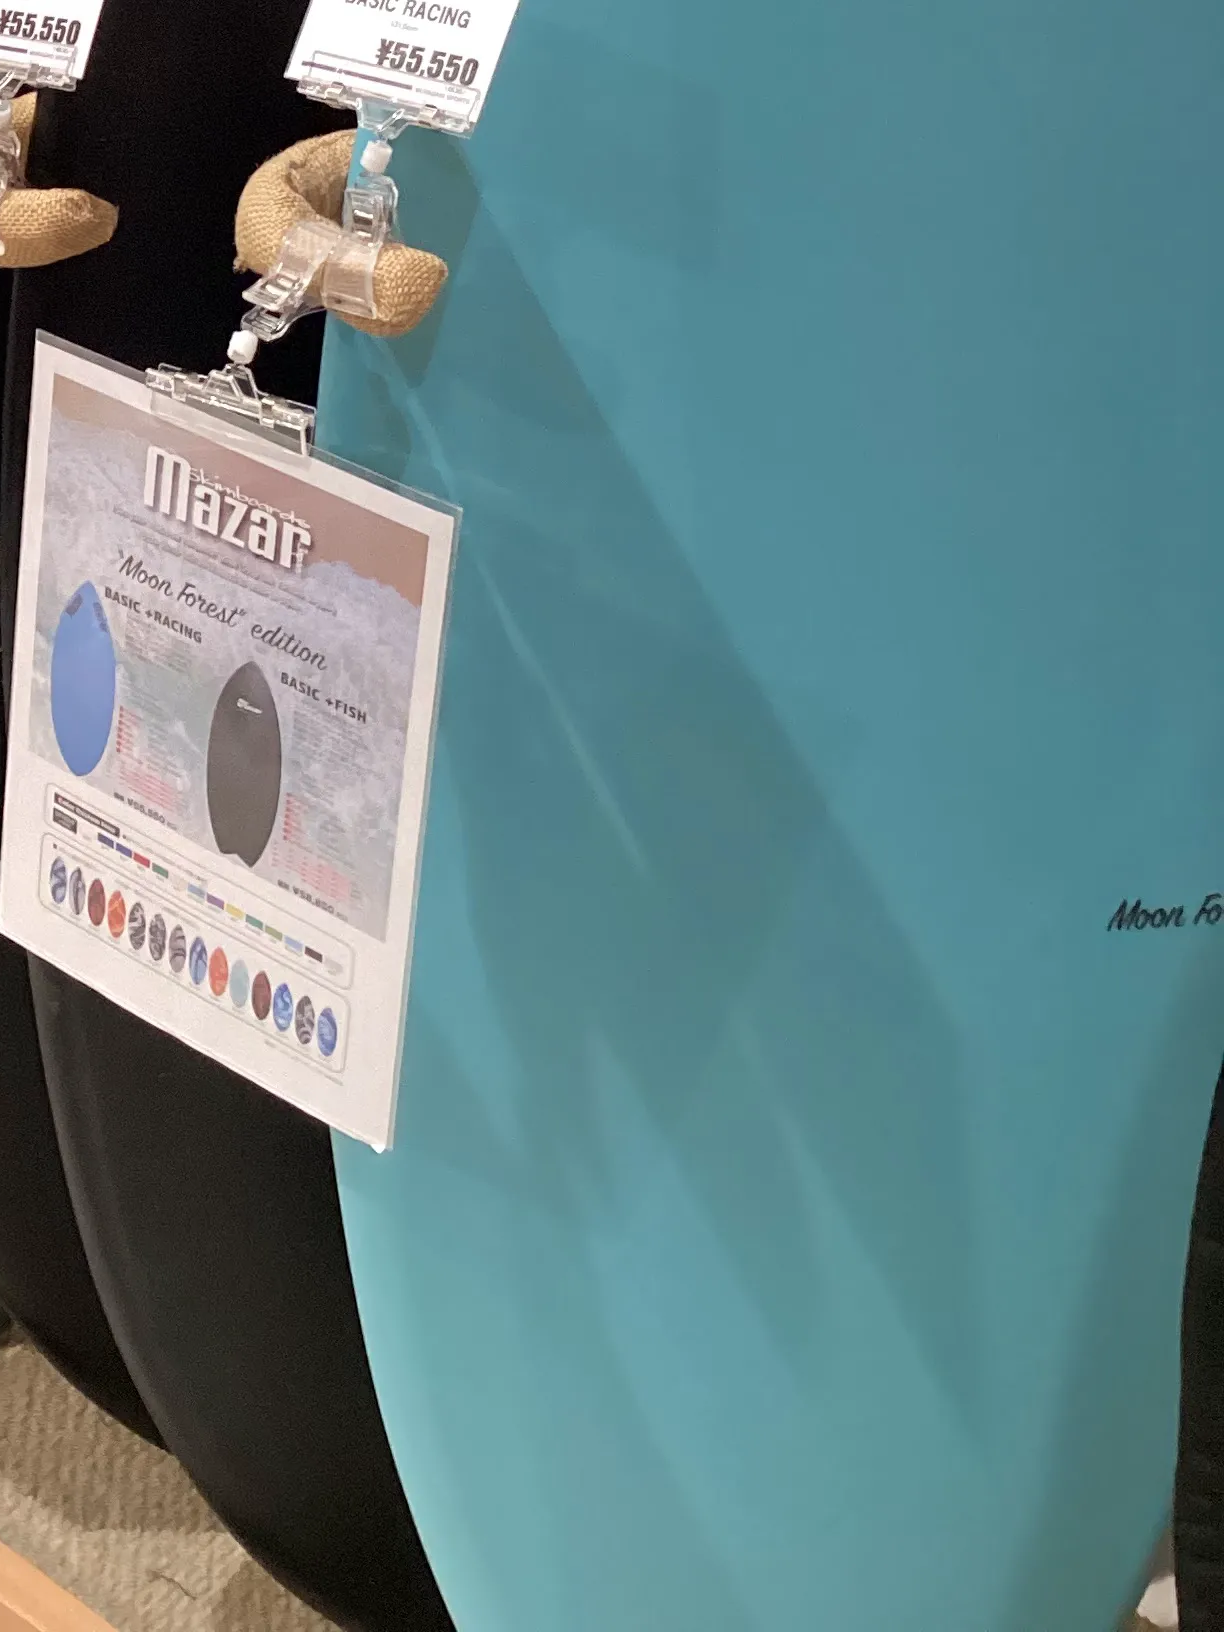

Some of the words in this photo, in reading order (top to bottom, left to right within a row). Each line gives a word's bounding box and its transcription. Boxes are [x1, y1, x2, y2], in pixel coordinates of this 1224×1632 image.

[375, 37, 480, 86] ¥55,550
[103, 586, 141, 614] BASIC
[144, 608, 203, 645] +RACING
[250, 623, 328, 671] edition
[280, 672, 320, 702] BASIC
[325, 698, 368, 725] +FISH
[1107, 898, 1185, 933] Moon
